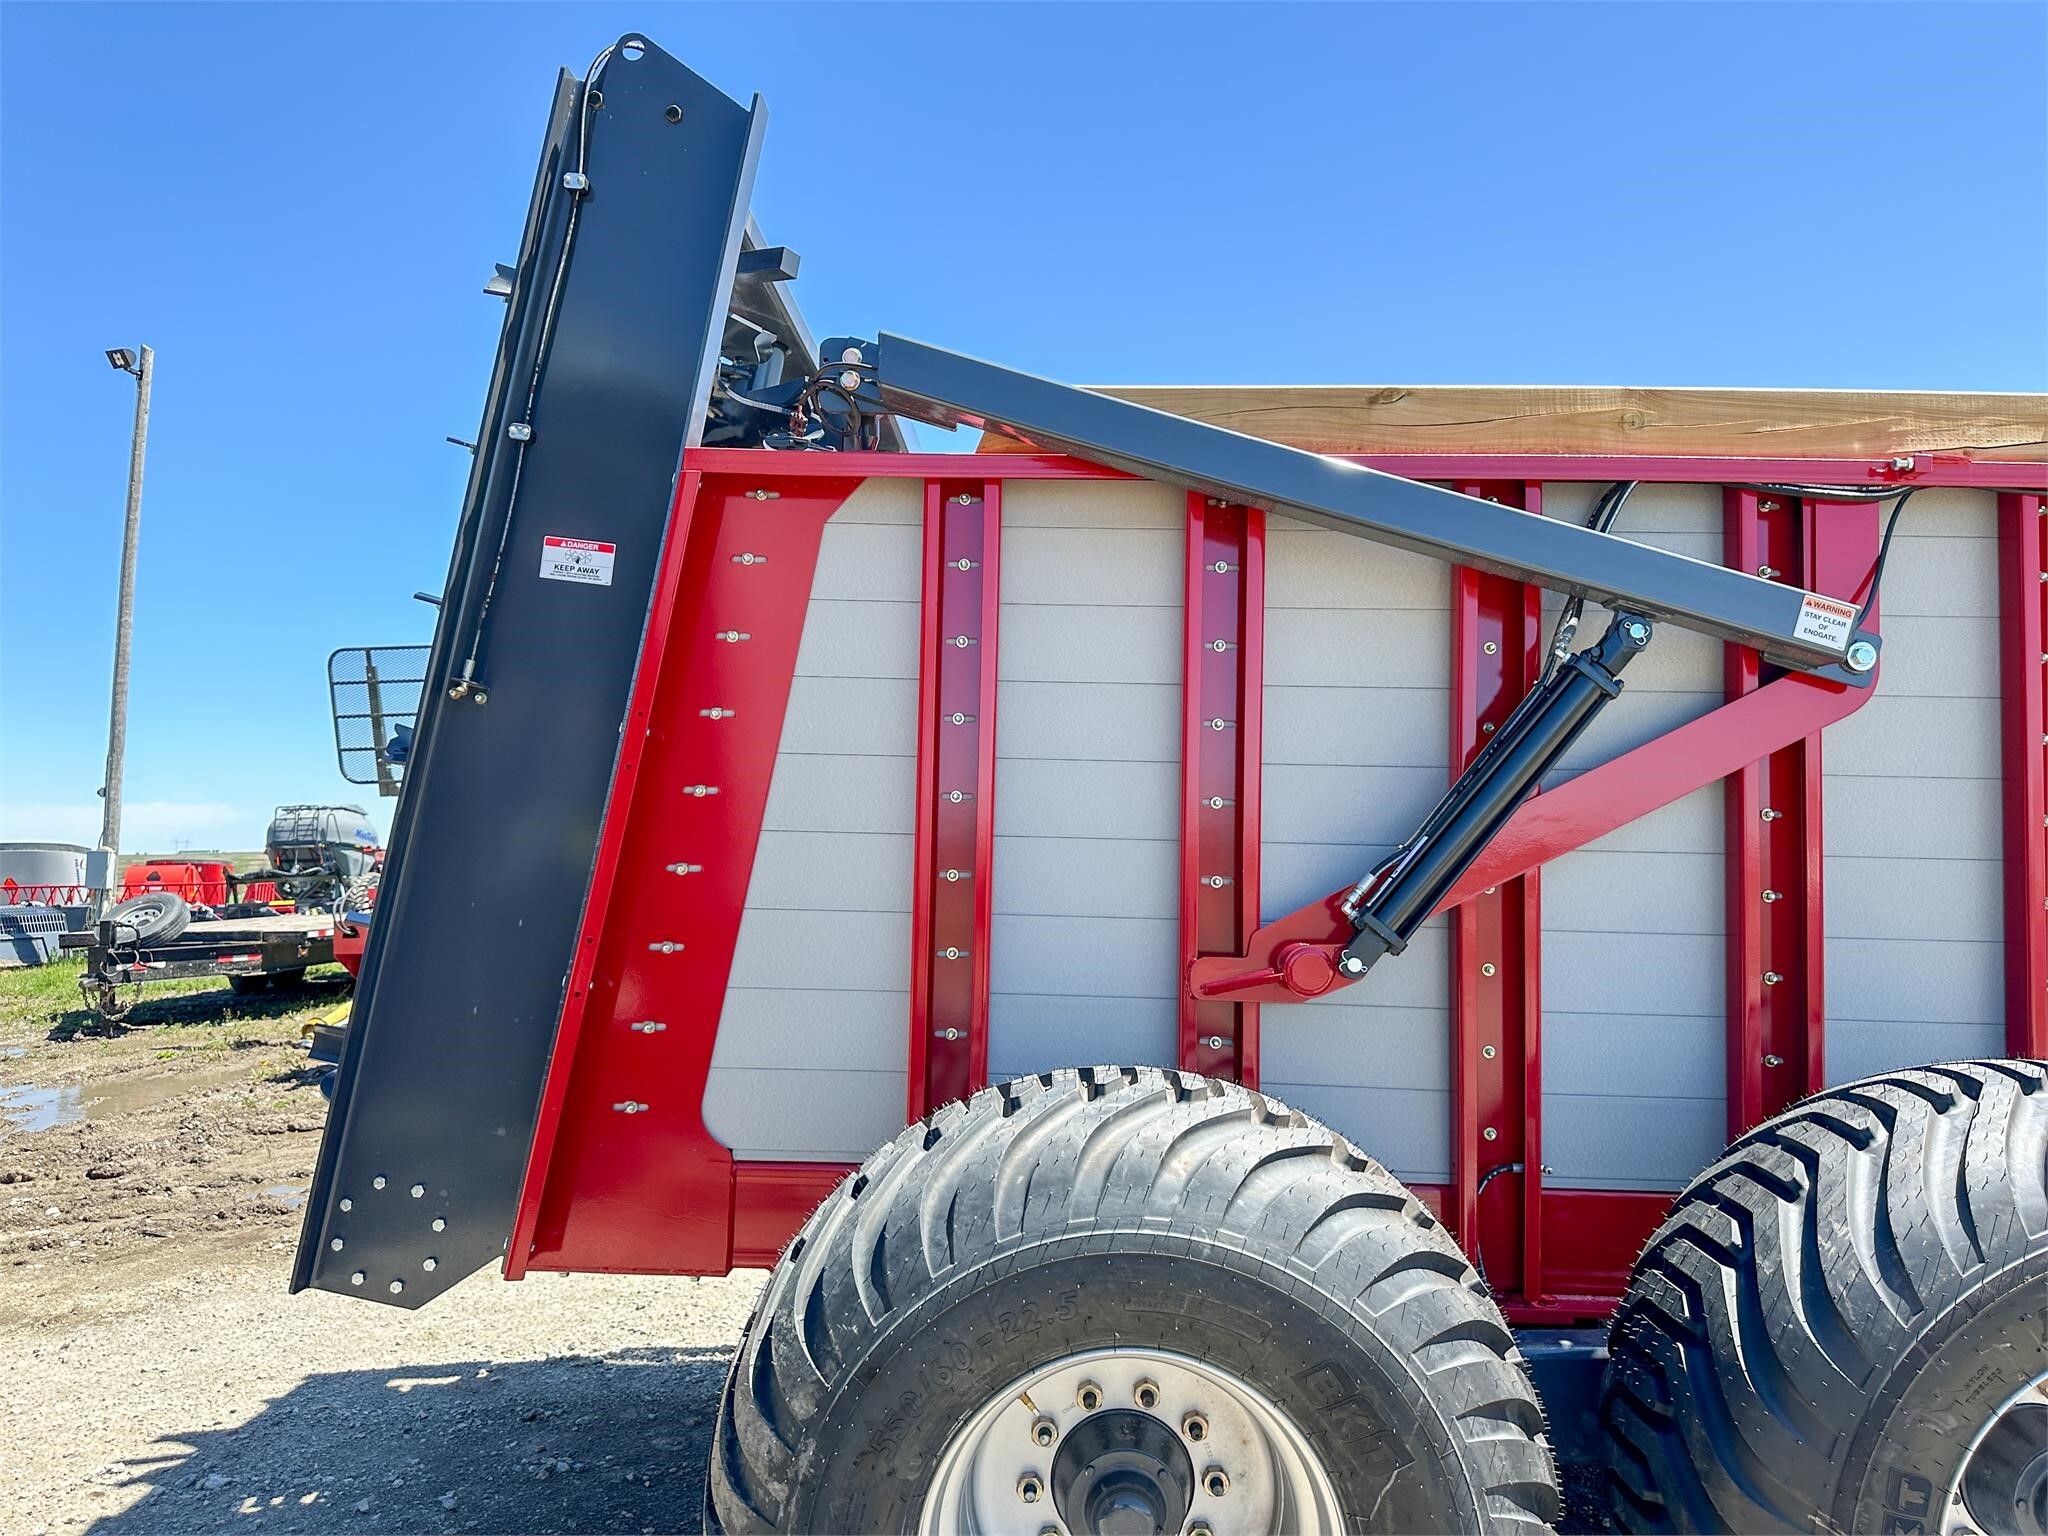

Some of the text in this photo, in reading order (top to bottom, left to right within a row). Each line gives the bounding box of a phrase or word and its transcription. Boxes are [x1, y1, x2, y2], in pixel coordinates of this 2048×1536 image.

[567, 541, 599, 551] DANGER
[554, 563, 575, 572] KEEP
[577, 567, 600, 575] AWAY
[1814, 601, 1852, 618] WARNING
[1804, 611, 1847, 628] STAY CLEAR
[1963, 1364, 1989, 1390] NYLON
